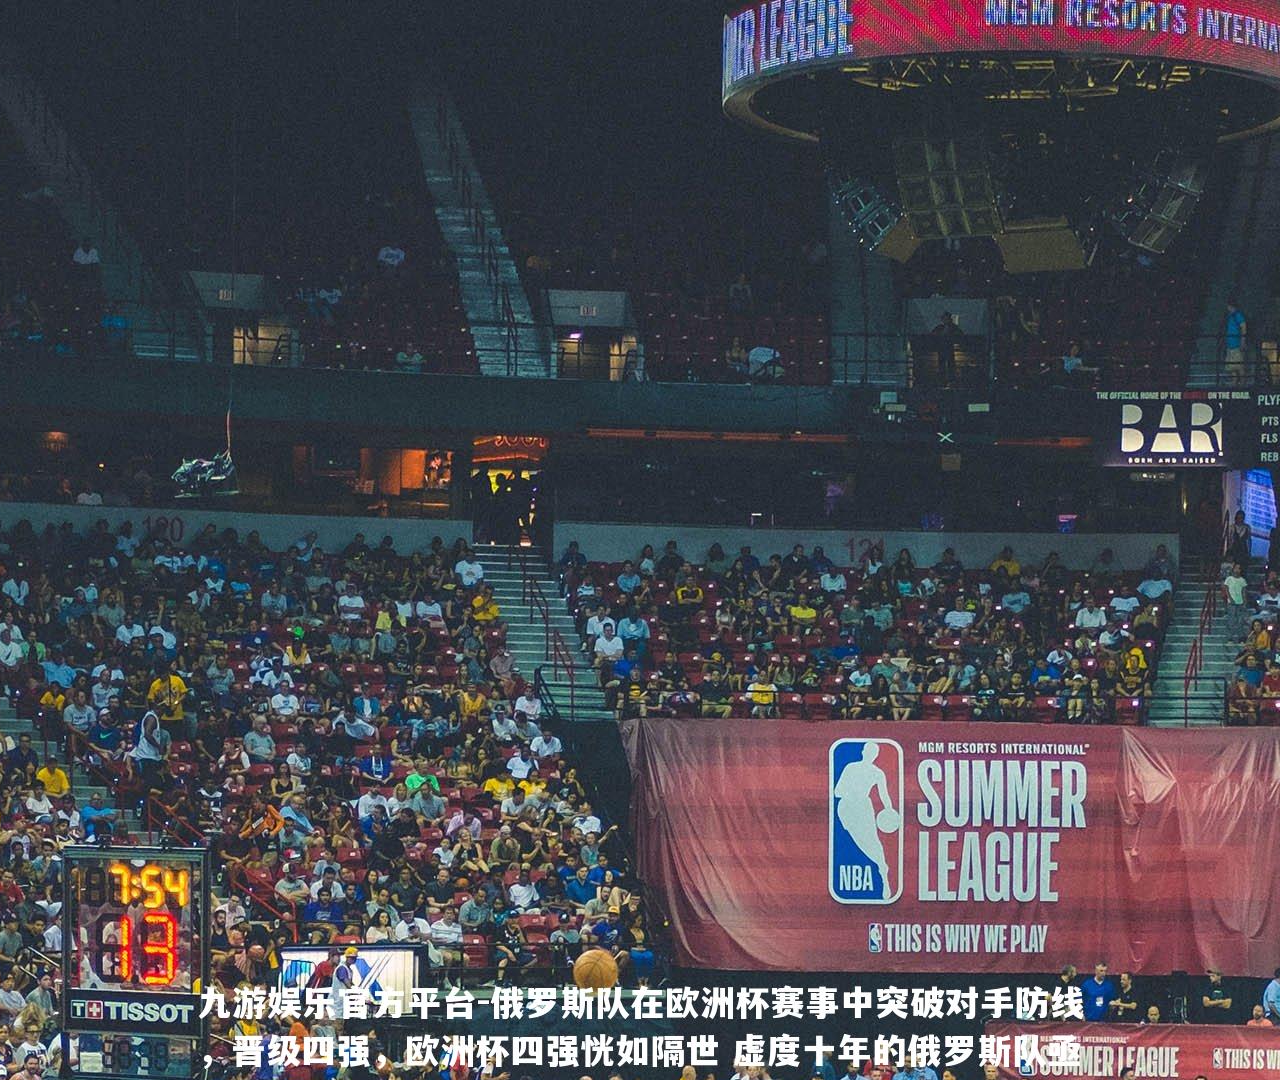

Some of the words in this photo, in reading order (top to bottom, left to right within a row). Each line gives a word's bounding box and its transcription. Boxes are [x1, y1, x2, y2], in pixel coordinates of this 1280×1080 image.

[1065, 0, 1188, 36] RESORTS
[760, 0, 853, 70] LEAGUE
[1096, 392, 1108, 400] THE
[1170, 392, 1181, 400] THE
[1262, 416, 1279, 426] PTS
[1261, 433, 1278, 444] FLS
[1261, 452, 1279, 462] REB
[919, 742, 944, 754] MGM
[948, 742, 997, 754] RESORTS
[1001, 743, 1087, 755] INTERNATIONAL
[918, 758, 1087, 828] SUMMER
[839, 864, 874, 892] NBA
[918, 831, 1060, 902] LEAGUE
[109, 863, 190, 908] 7:54
[120, 912, 179, 986] 13
[885, 924, 921, 952] THIS
[926, 924, 941, 952] IS
[944, 924, 982, 952] WHY
[983, 924, 1008, 952] WE
[1010, 924, 1048, 953] PLAY
[104, 1001, 194, 1024] TISSOT
[1225, 1048, 1251, 1070] THIS
[1252, 1048, 1263, 1070] IS
